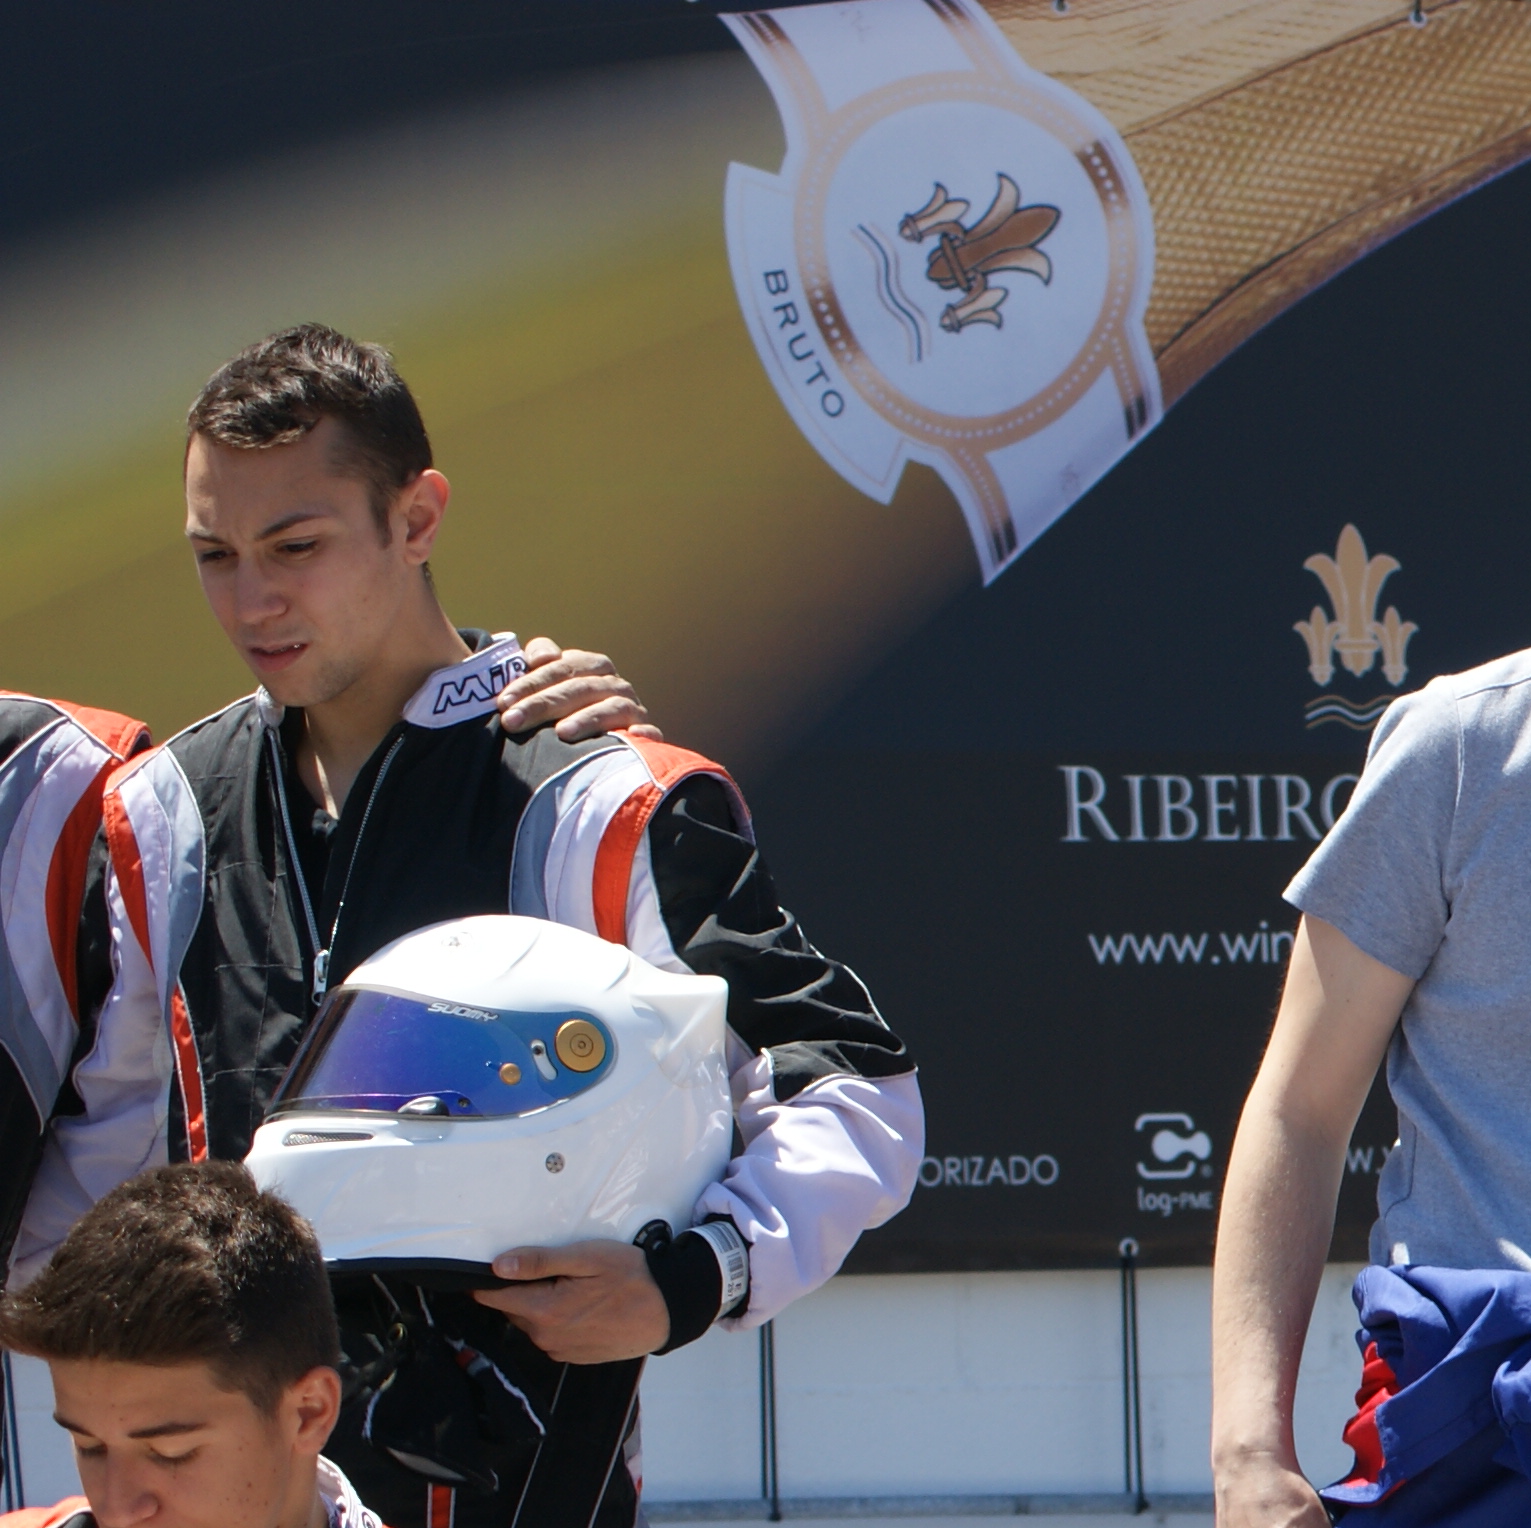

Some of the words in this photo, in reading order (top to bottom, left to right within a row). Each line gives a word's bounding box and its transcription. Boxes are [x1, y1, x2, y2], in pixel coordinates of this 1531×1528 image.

[763, 269, 845, 418] BRUTO
[427, 1002, 499, 1022] SUOMY
[917, 1154, 1060, 1187] ORIZADO
